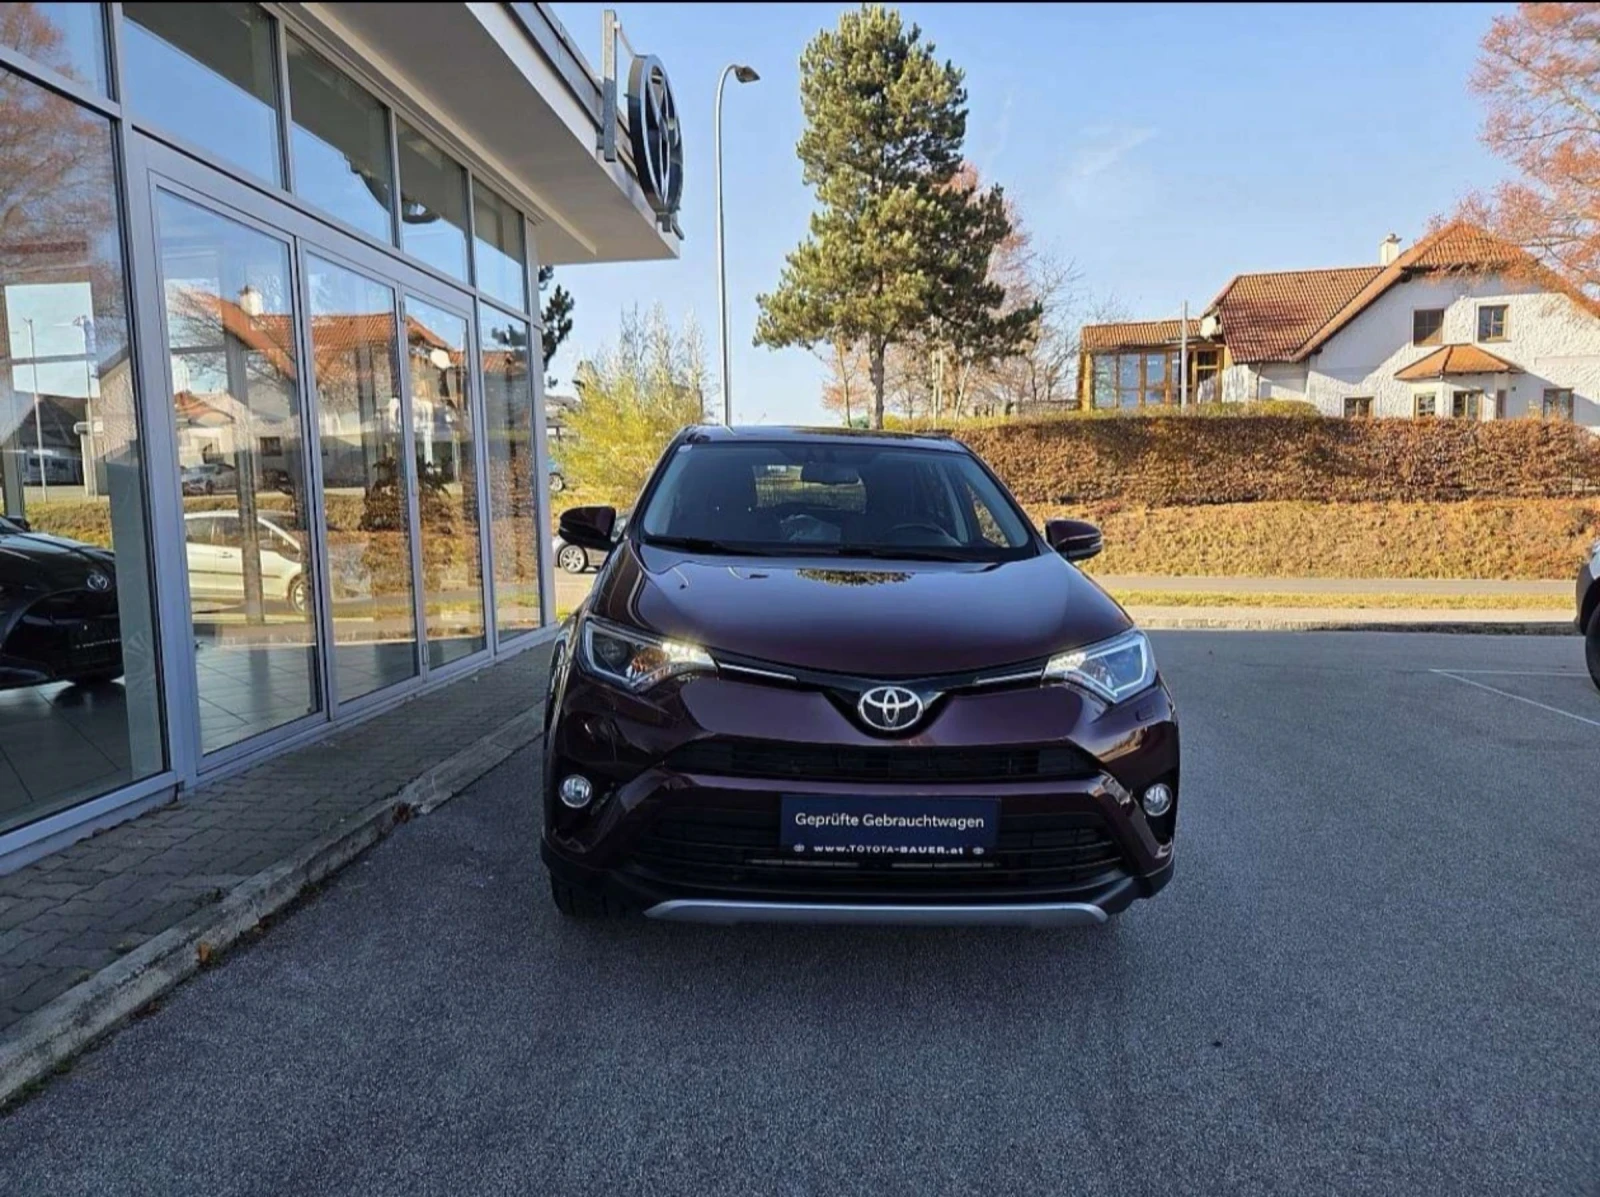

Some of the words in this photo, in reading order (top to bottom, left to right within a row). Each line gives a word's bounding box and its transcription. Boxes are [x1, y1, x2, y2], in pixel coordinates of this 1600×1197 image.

[795, 812, 859, 828] Geprüfte
[862, 813, 984, 831] Gebrauchtwagen
[813, 844, 964, 855] www.TOYOTA-BAUER.at
